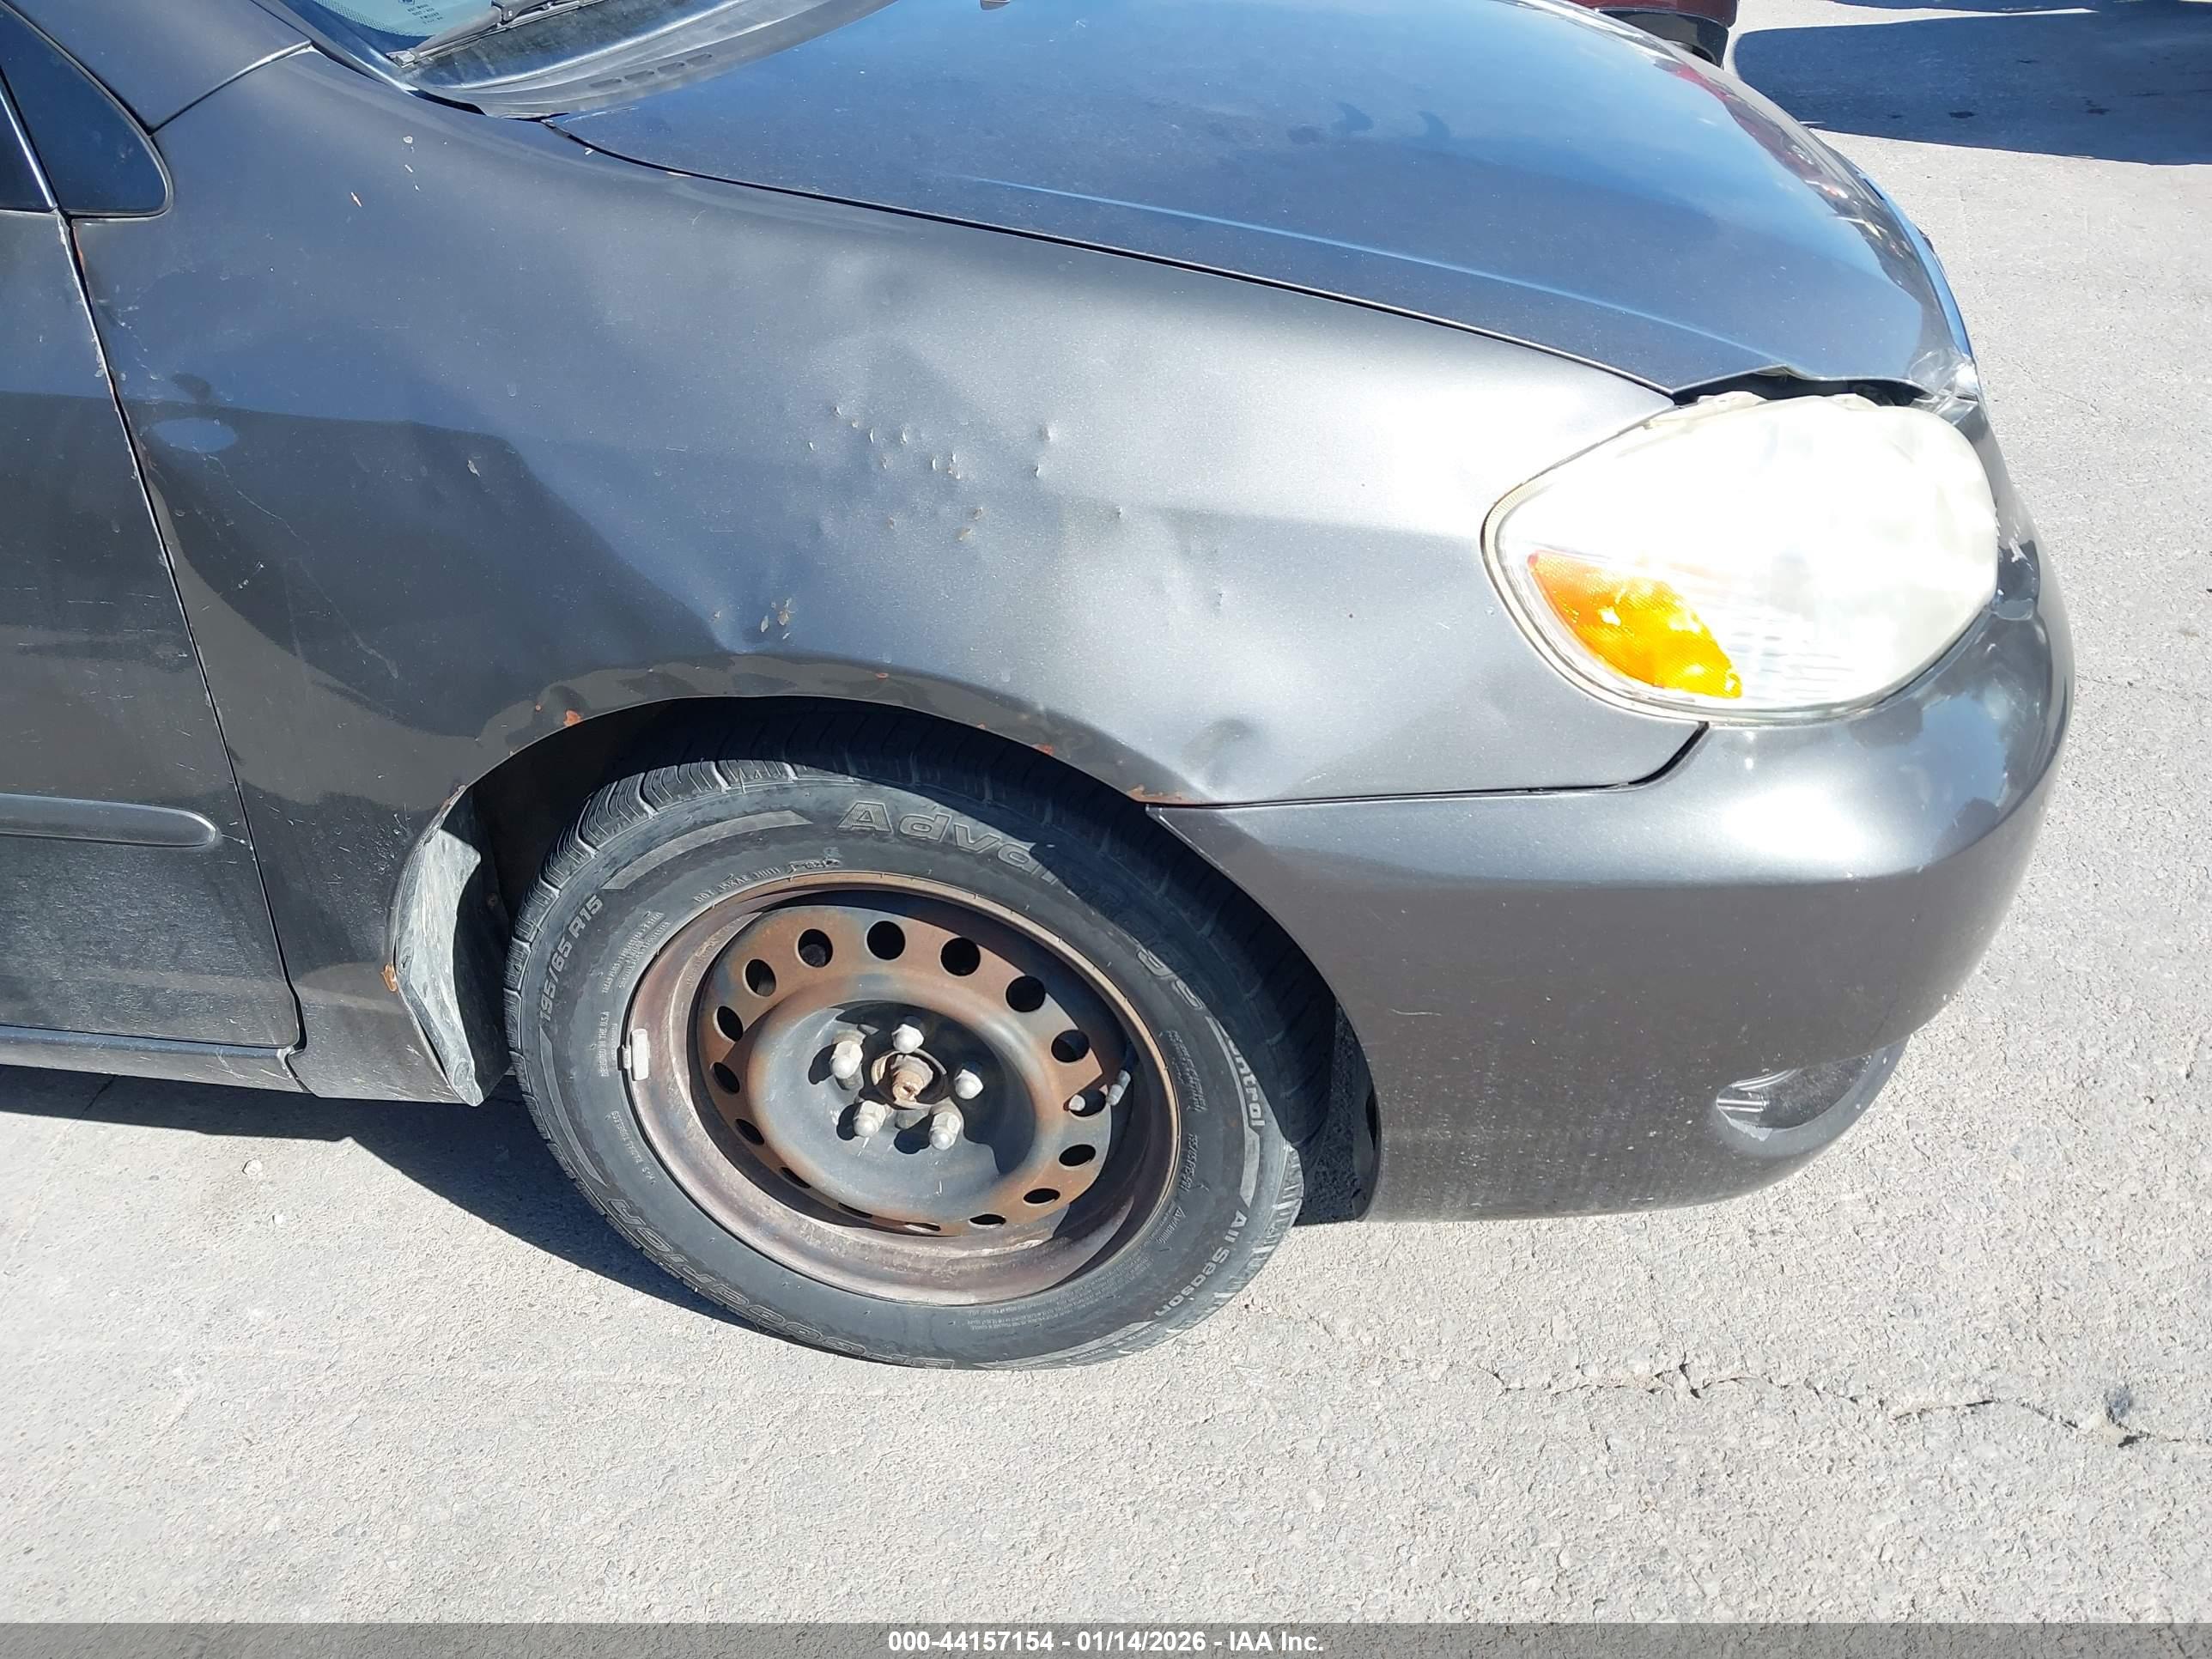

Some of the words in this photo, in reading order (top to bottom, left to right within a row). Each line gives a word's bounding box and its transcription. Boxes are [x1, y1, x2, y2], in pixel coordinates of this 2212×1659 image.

[538, 934, 574, 1021] 195/65
[566, 891, 604, 939] R15
[1215, 1020, 1266, 1127] ontrol
[1223, 1208, 1248, 1243] All
[1153, 1245, 1231, 1318] Season
